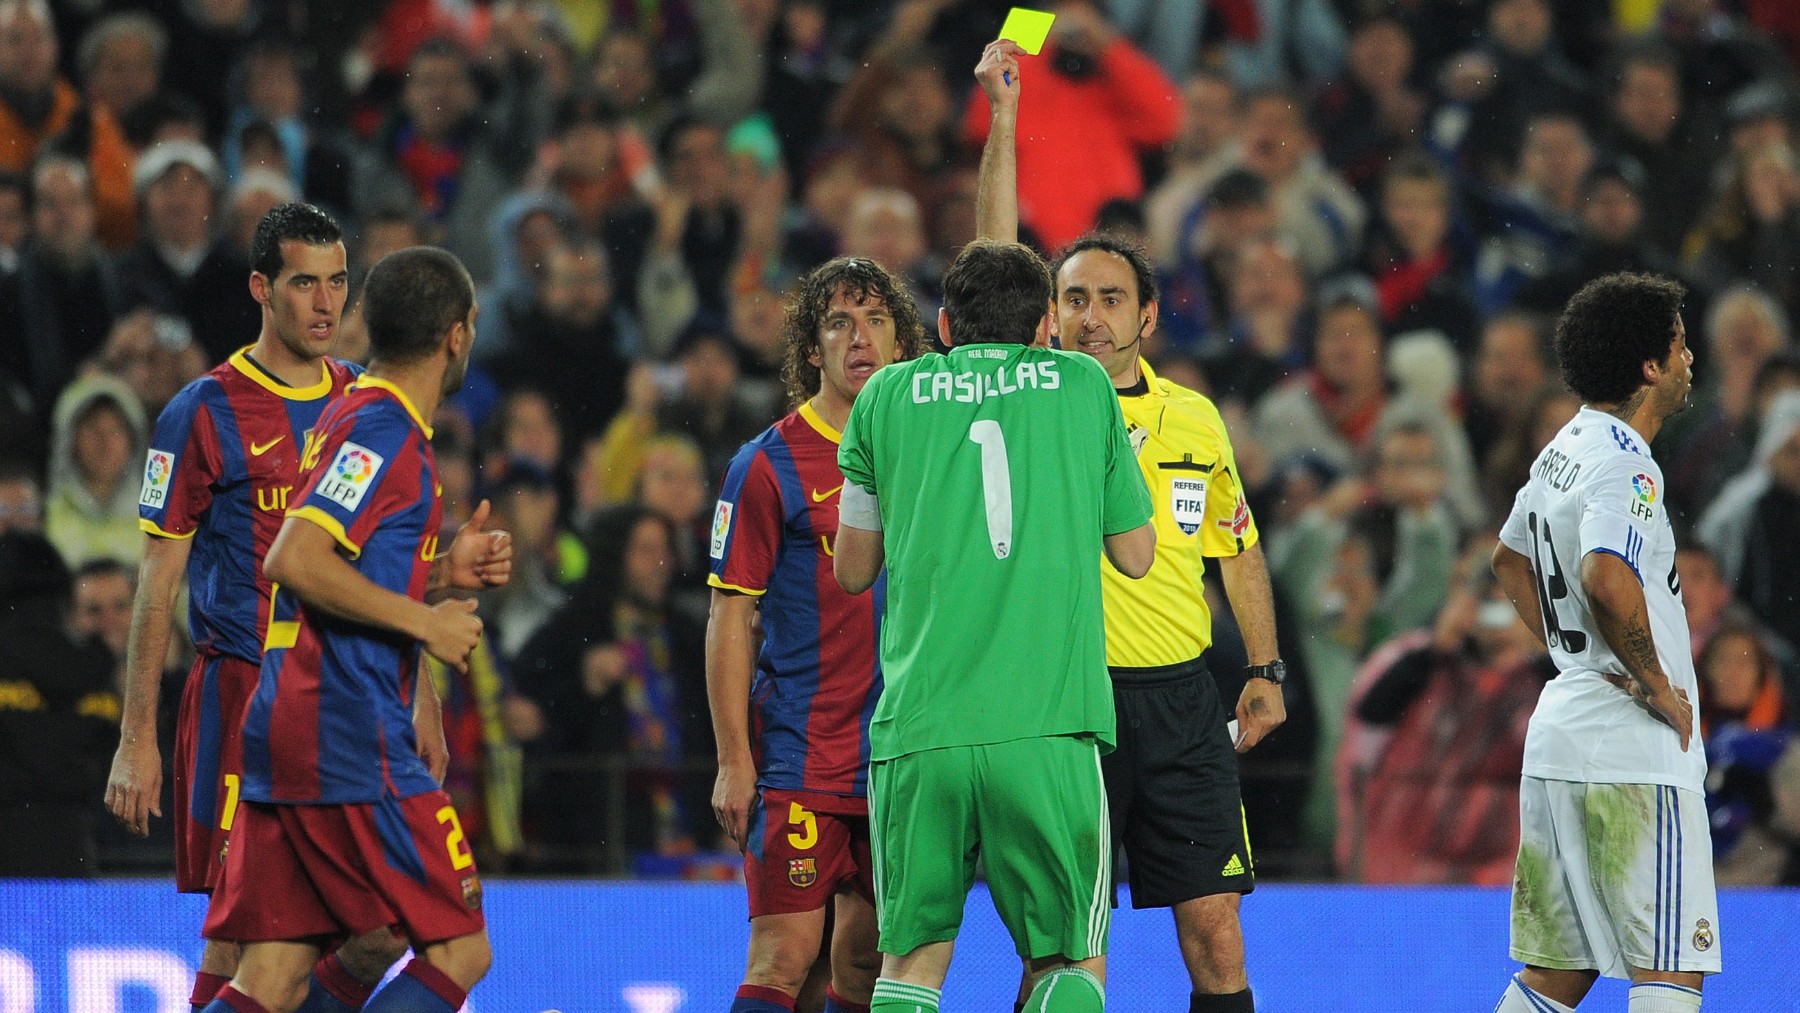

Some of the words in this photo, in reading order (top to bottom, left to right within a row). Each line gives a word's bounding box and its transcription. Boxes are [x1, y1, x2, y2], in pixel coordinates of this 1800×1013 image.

[912, 360, 1060, 404] CASILLAS
[142, 487, 163, 505] LFP
[322, 480, 356, 501] LFP
[969, 419, 1012, 560] 1
[1174, 481, 1204, 491] REFEREE
[1176, 499, 1202, 513] FIFA
[1631, 498, 1653, 521] LFP
[788, 801, 818, 850] 5
[435, 805, 473, 871] 2
